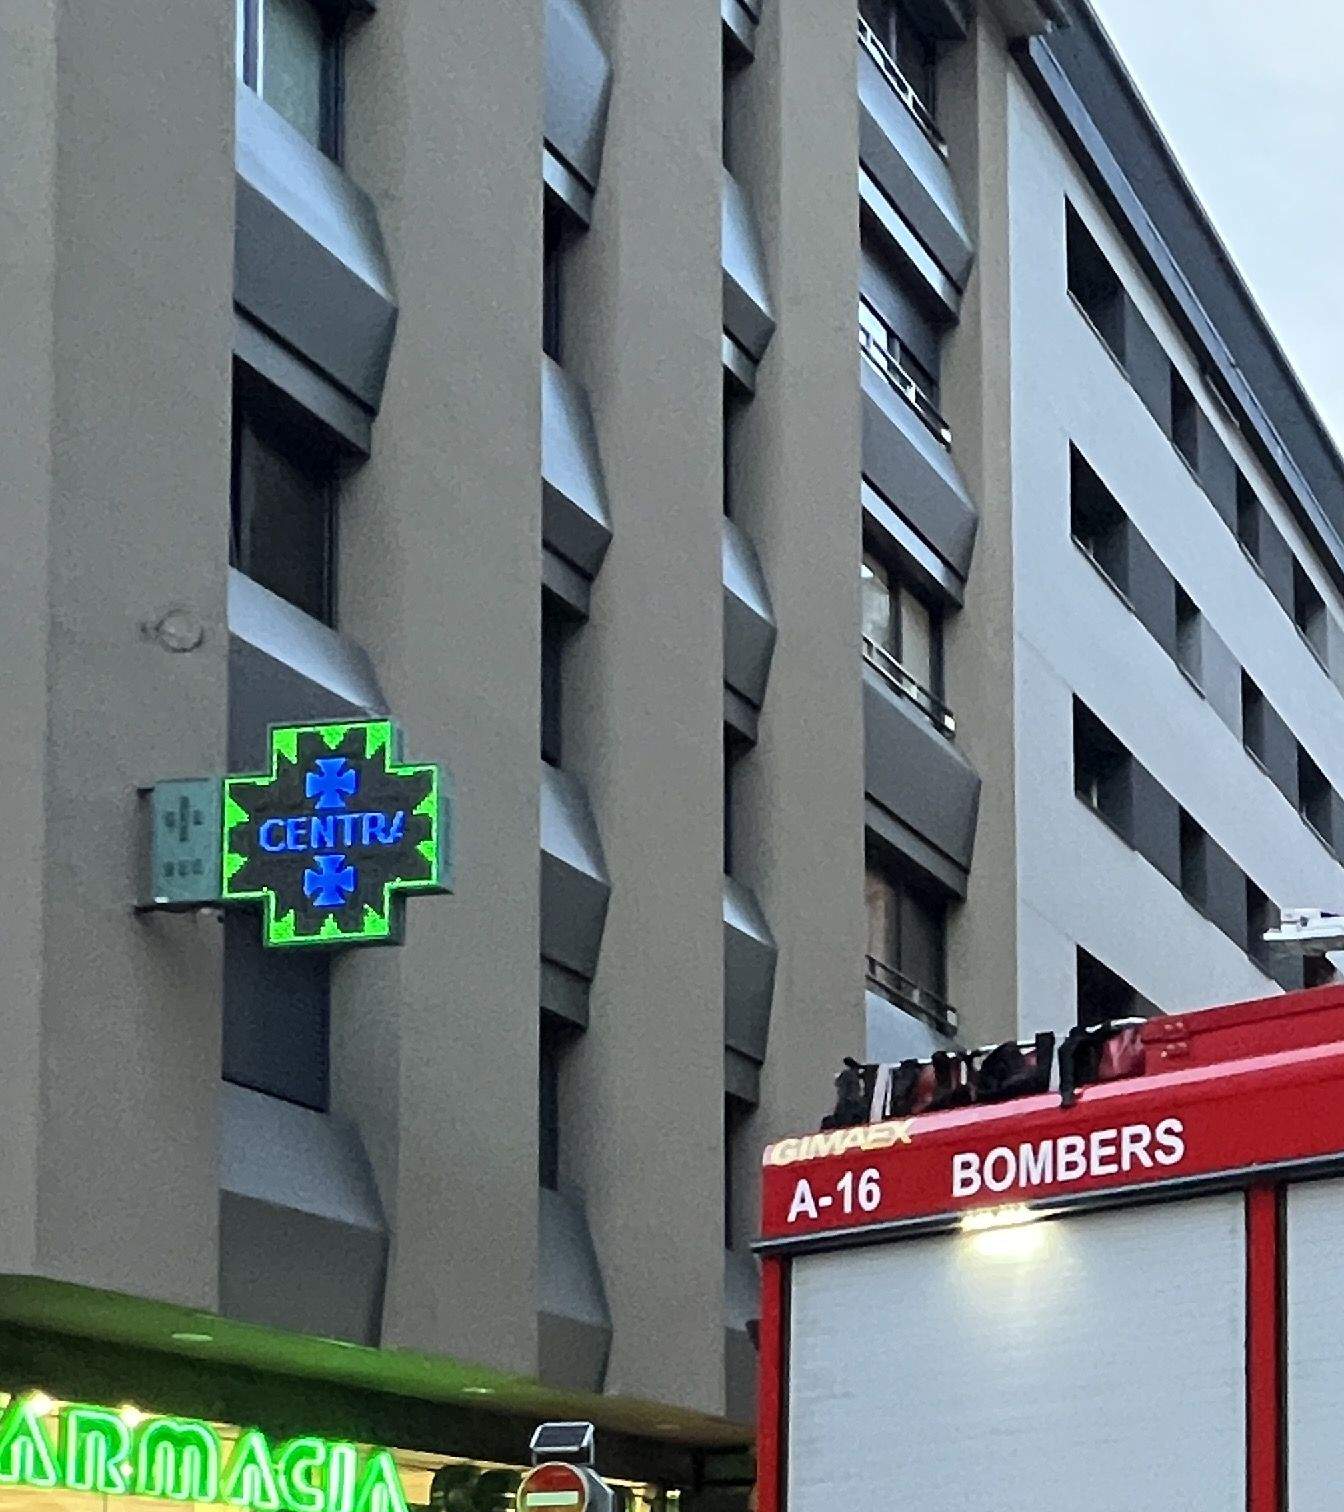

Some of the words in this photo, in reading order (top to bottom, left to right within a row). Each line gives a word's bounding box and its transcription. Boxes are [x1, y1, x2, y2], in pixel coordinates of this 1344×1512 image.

[771, 1118, 913, 1165] GIMAEX
[787, 1168, 882, 1223] A-16
[952, 1117, 1186, 1198] BOMBERS
